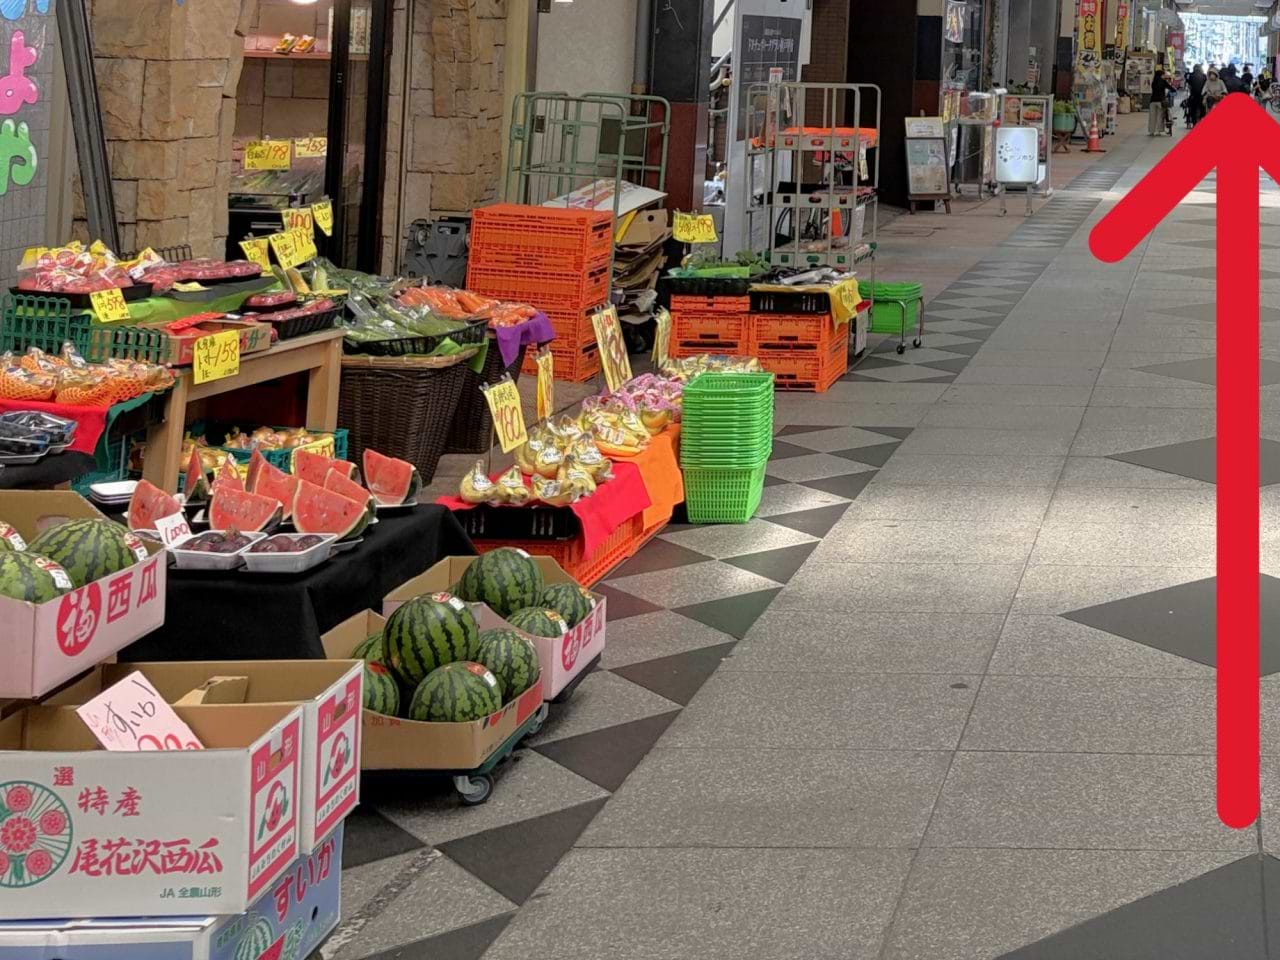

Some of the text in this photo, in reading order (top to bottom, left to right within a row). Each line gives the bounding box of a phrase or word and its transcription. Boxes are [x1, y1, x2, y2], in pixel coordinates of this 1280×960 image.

[52, 766, 74, 787] 選
[77, 786, 143, 817] 特産
[68, 837, 223, 877] 尾花沢西瓜
[160, 888, 175, 899] JA
[273, 839, 336, 924] すいか
